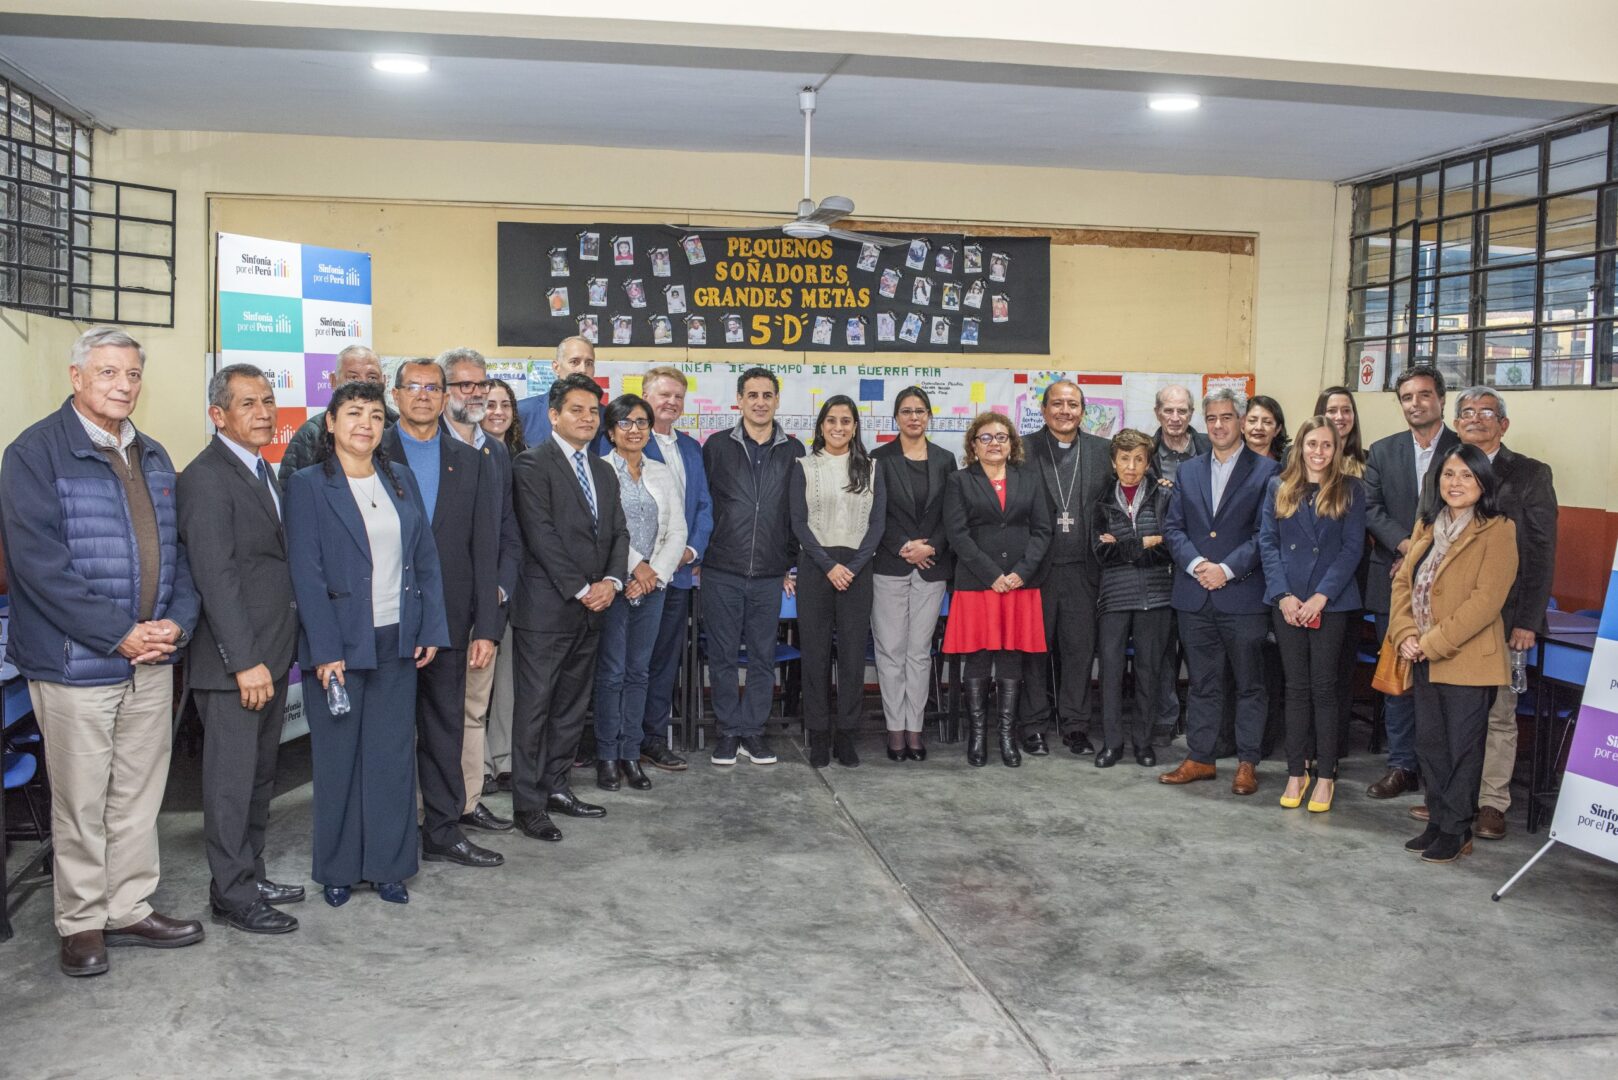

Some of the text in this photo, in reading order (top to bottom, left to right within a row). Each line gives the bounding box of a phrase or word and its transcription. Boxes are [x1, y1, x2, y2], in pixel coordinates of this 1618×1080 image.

[241, 253, 272, 266] Sinfonía
[235, 265, 272, 276] por el Perú
[694, 287, 793, 308] GRANDES
[801, 287, 871, 309] METAS
[319, 317, 346, 328] Sinfonía
[331, 328, 346, 337] Perú
[812, 365, 828, 375] DE
[831, 365, 847, 375] LA
[857, 365, 909, 377] GUERRA
[1594, 747, 1612, 759] por
[1590, 803, 1618, 822] Sinfo
[1577, 815, 1618, 836] por el Pe
